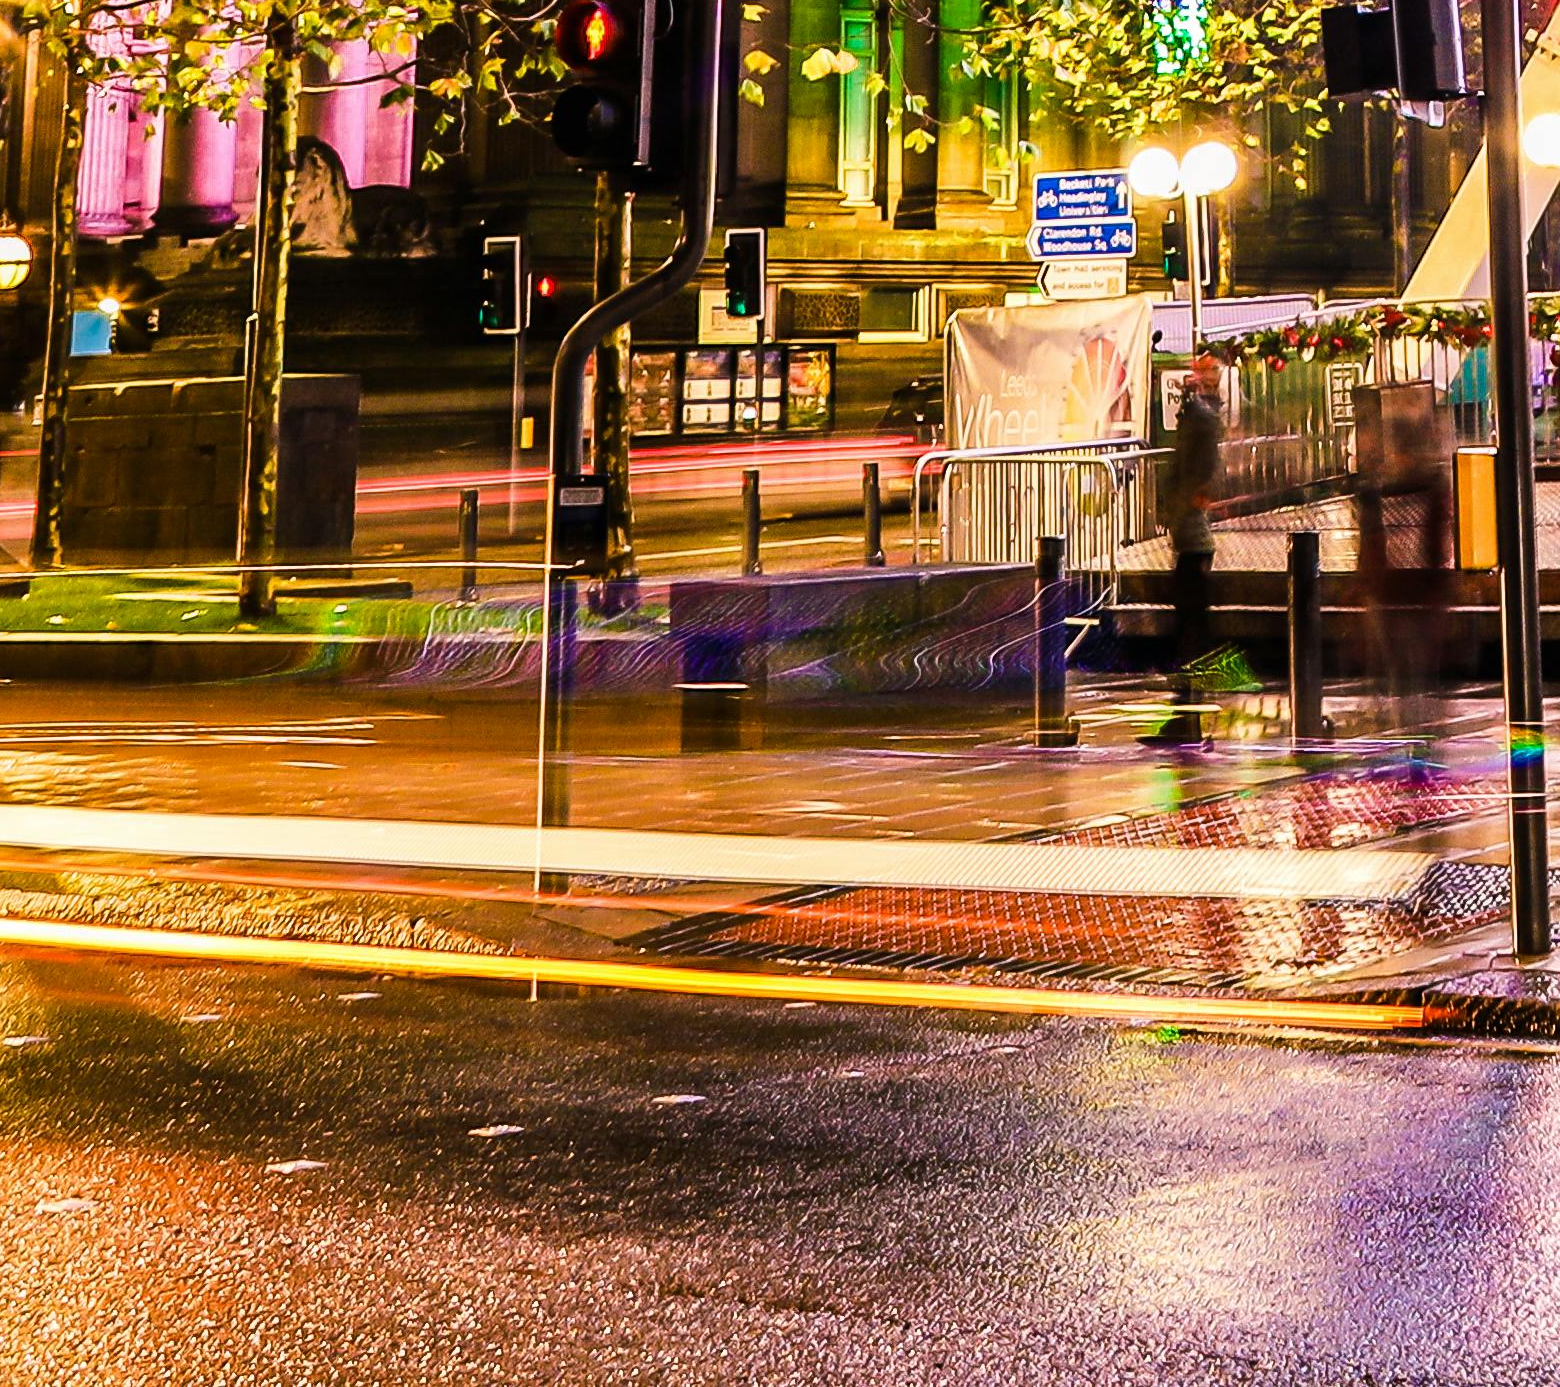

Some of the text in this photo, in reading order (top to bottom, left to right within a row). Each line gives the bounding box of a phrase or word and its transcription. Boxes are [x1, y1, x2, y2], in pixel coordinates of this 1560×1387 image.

[1059, 191, 1107, 204] Headingley
[1043, 228, 1087, 239] Clarendon
[1043, 241, 1092, 252] Woodhouse
